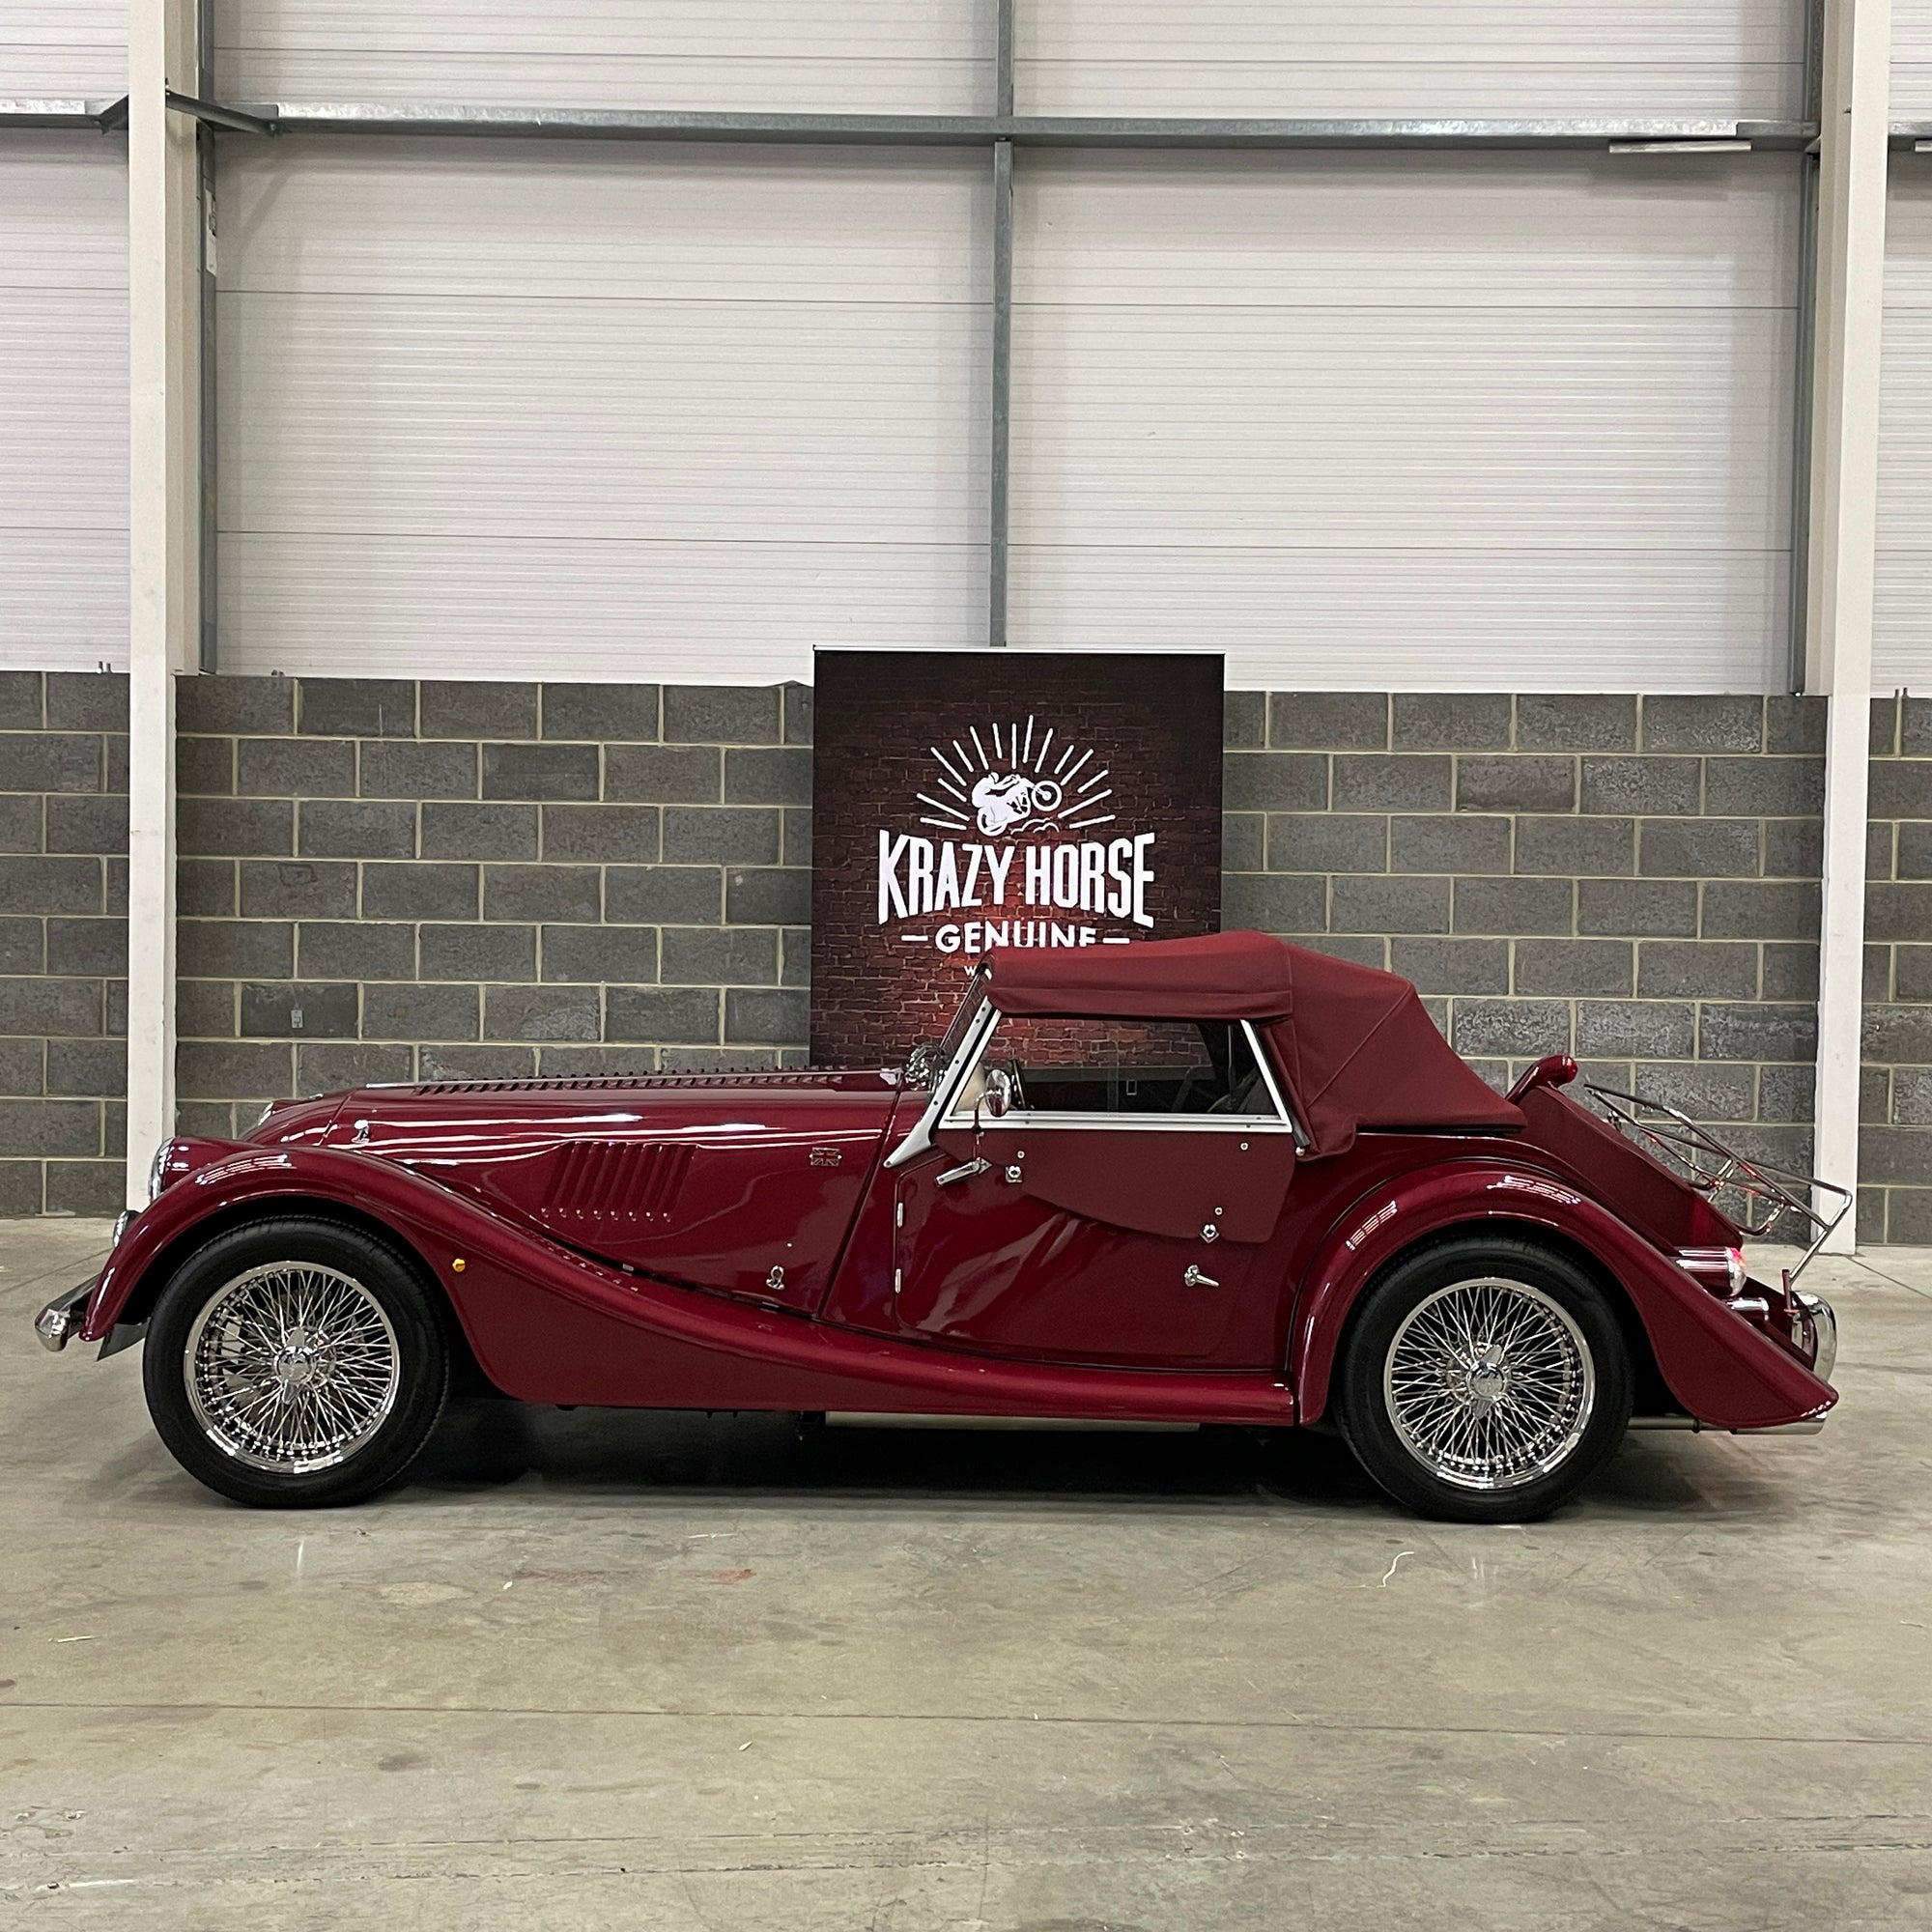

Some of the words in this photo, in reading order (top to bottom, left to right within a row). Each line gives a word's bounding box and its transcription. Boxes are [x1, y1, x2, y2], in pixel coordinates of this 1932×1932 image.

[878, 829, 1015, 925] KRAZY
[1025, 832, 1155, 928] HORSE
[935, 920, 1096, 953] GENUINE
